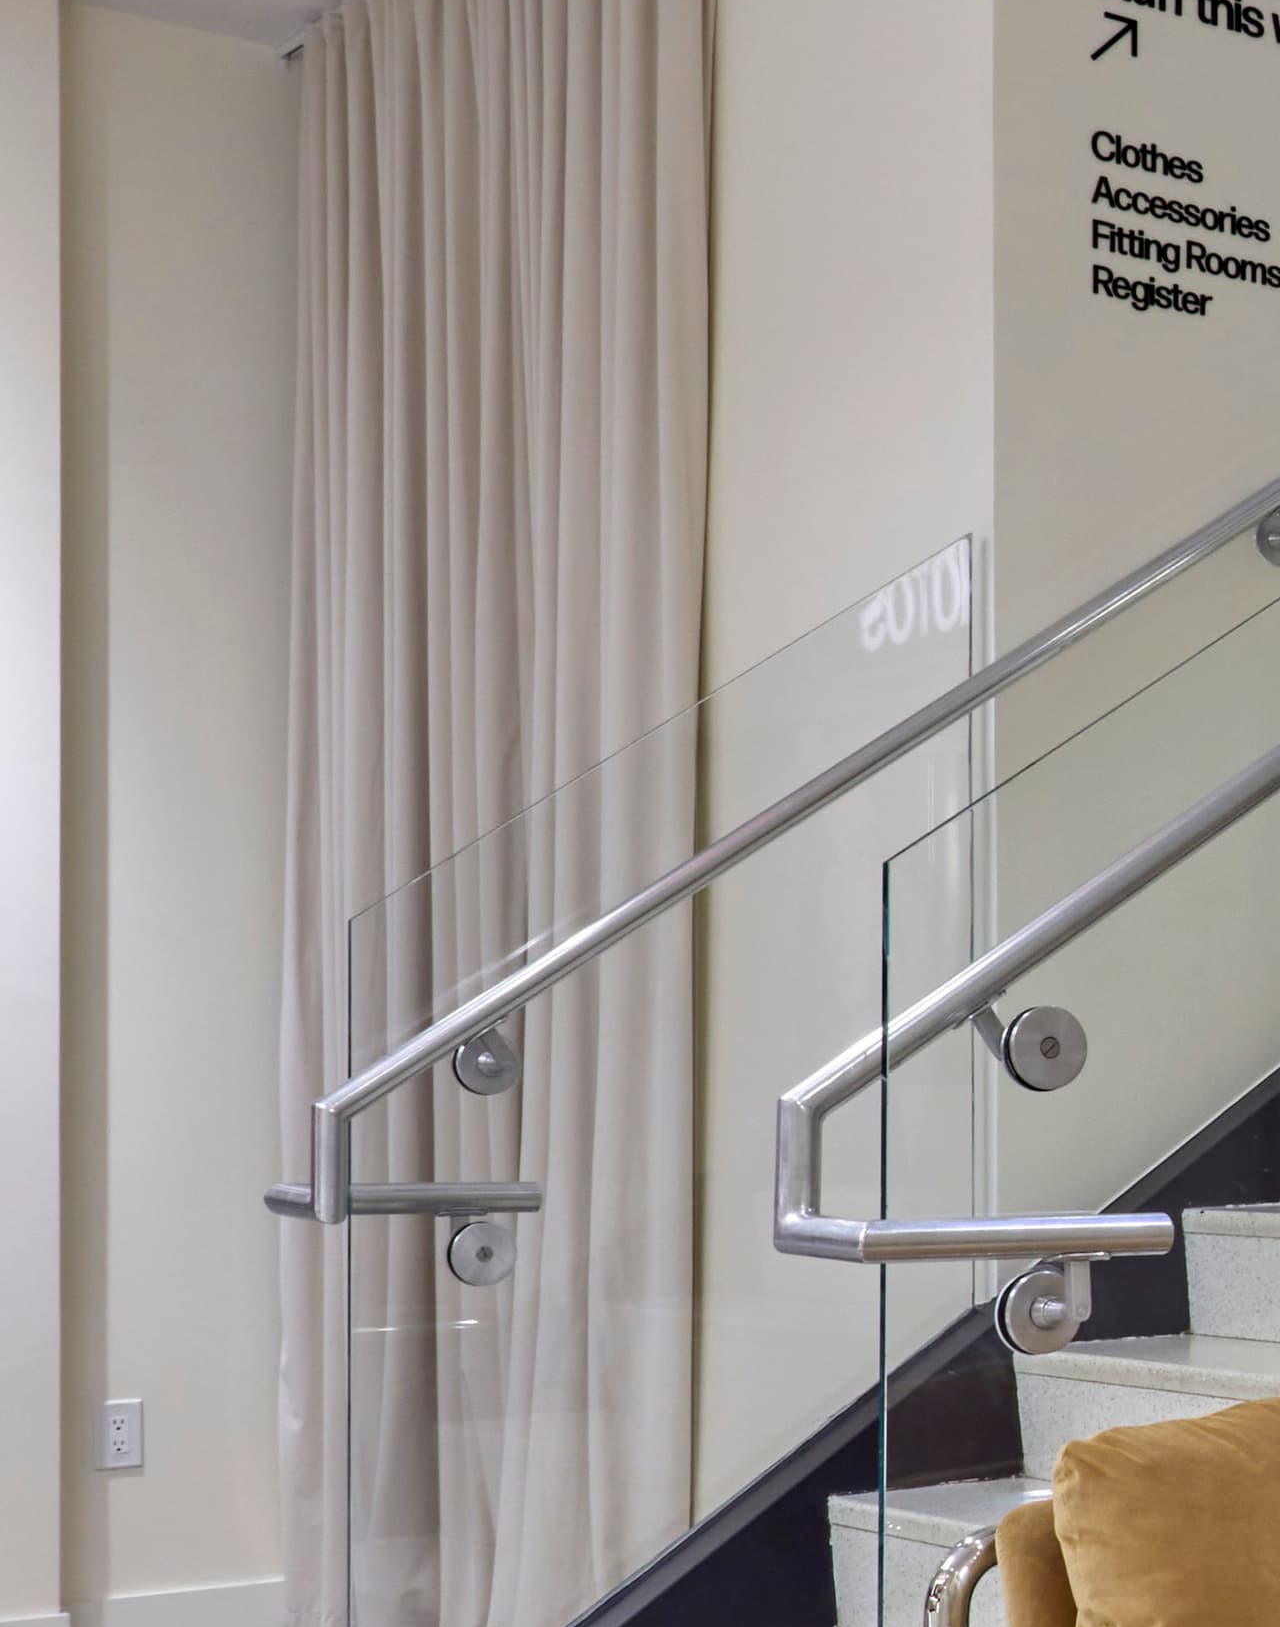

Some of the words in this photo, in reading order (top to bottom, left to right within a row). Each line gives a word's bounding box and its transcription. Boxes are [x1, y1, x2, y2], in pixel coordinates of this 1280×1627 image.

[1090, 130, 1204, 184] Clothes
[1091, 175, 1271, 243] Accessories
[1091, 218, 1181, 274] Fitting
[1092, 263, 1214, 317] Register
